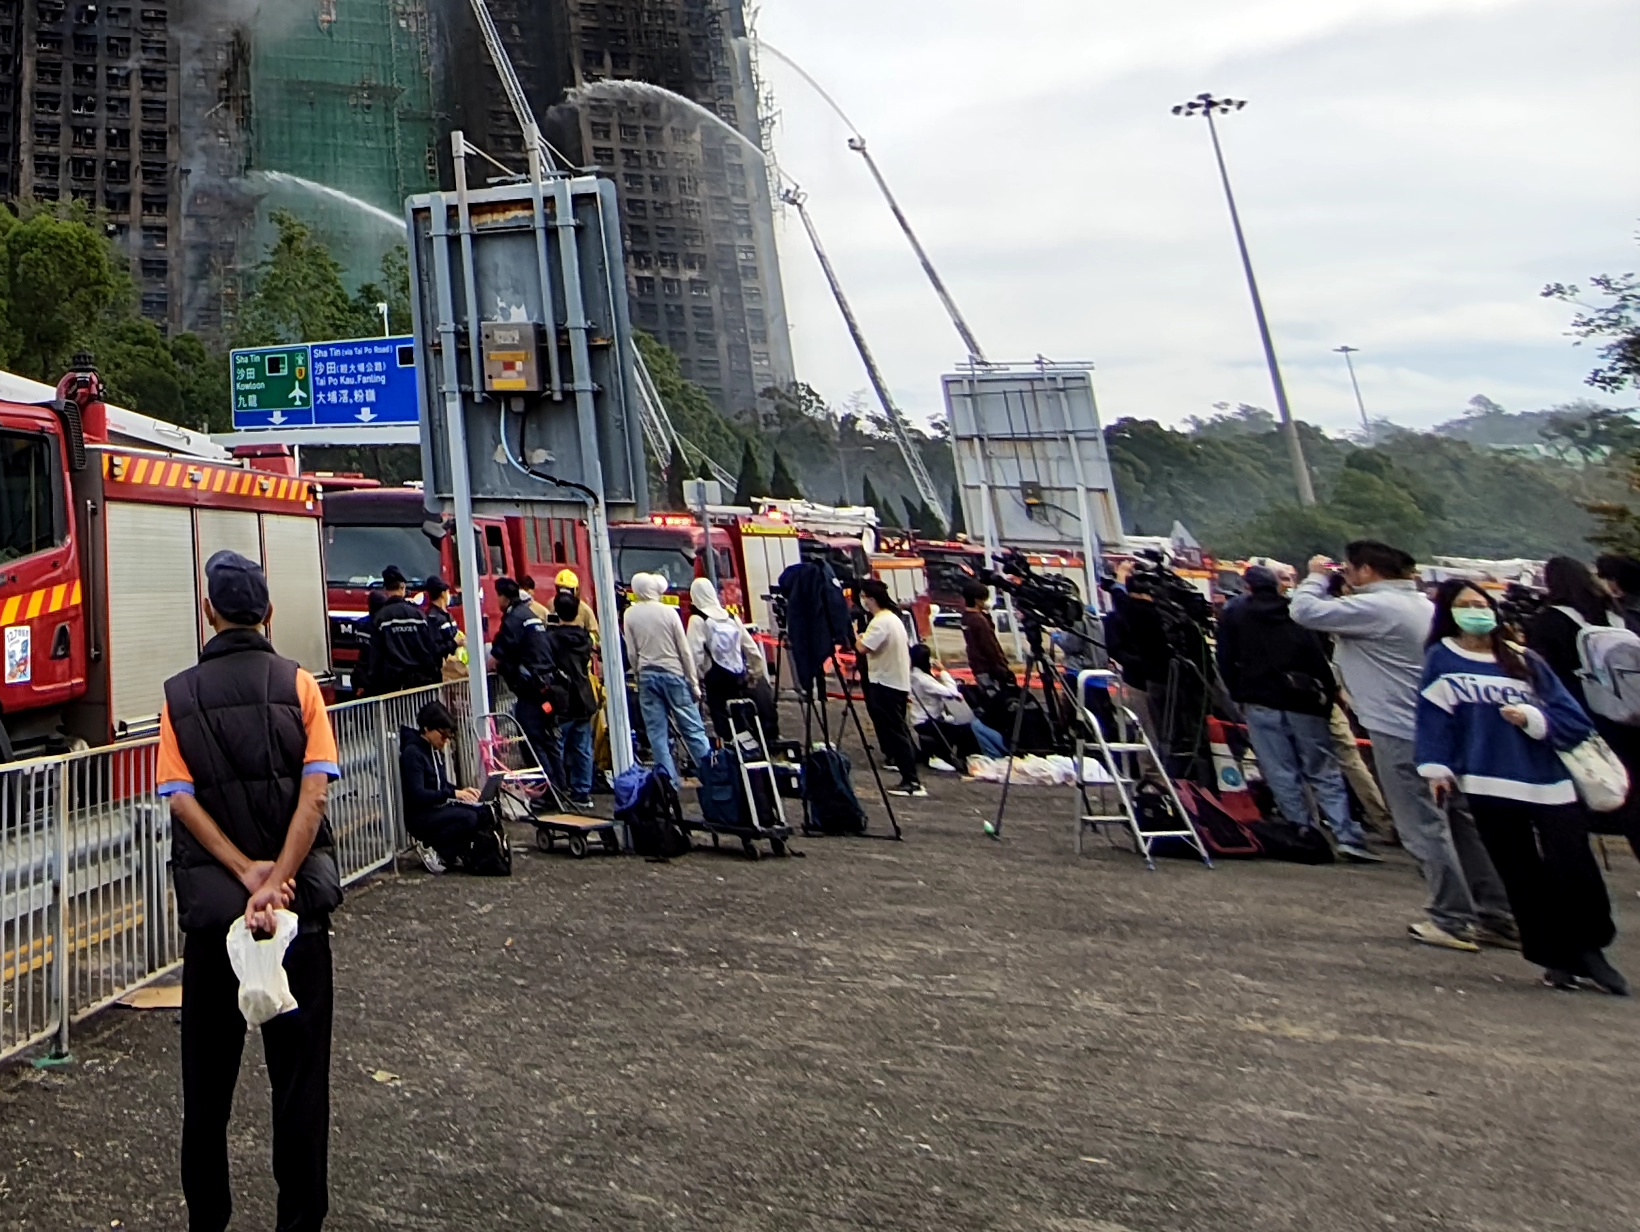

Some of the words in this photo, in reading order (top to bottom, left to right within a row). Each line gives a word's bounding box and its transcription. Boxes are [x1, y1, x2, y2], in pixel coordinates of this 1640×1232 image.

[313, 348, 328, 359] Sha
[329, 347, 341, 357] Tin
[354, 346, 363, 355] Tai
[364, 346, 373, 355] Po
[235, 354, 249, 364] Sha
[250, 354, 260, 363] Tin
[236, 367, 255, 380] 沙田
[236, 381, 265, 390] Kowloon
[315, 376, 326, 386] Tai
[328, 376, 338, 385] Po
[237, 394, 258, 408] 九龍
